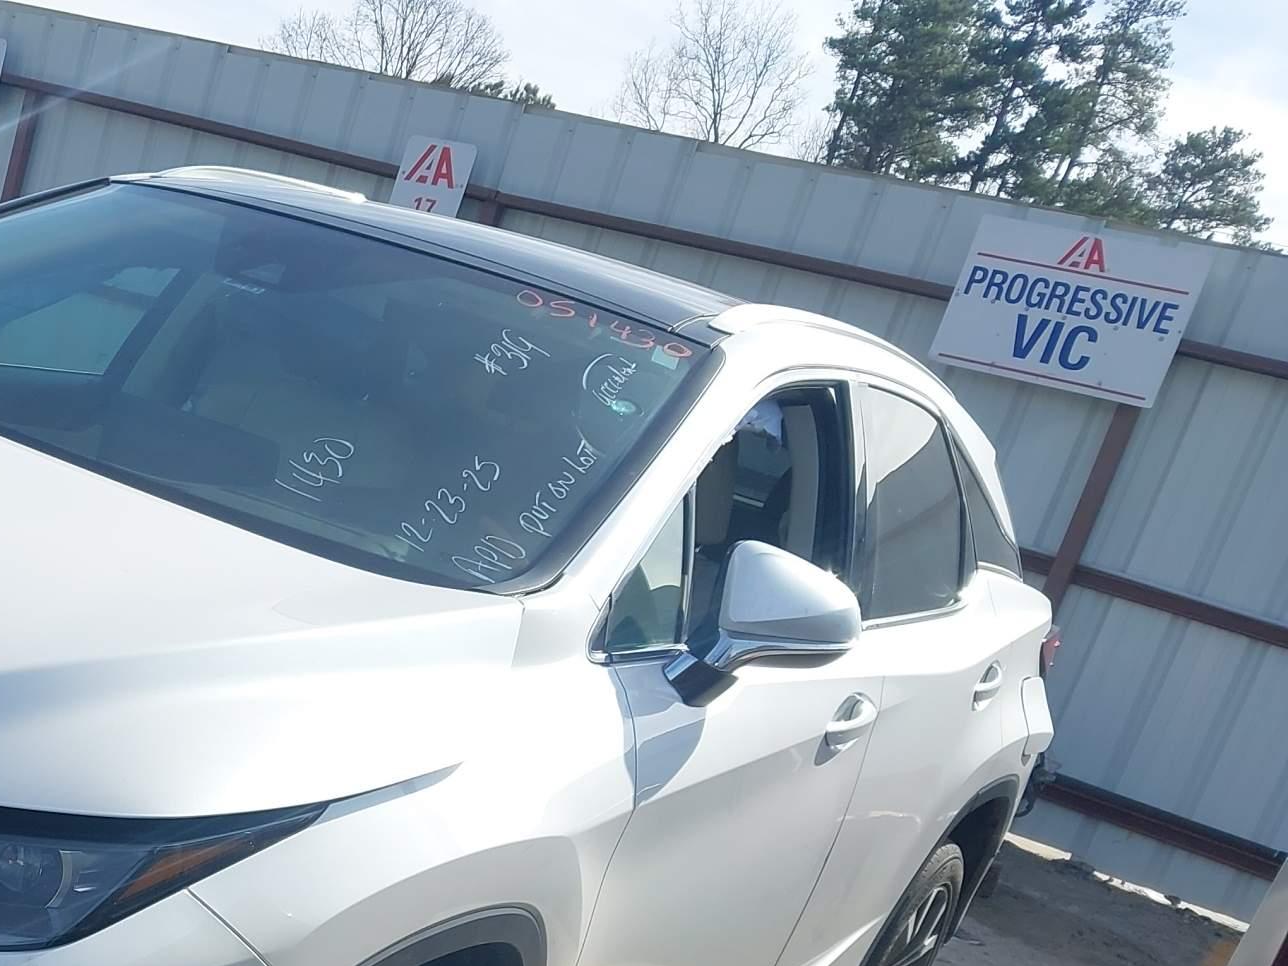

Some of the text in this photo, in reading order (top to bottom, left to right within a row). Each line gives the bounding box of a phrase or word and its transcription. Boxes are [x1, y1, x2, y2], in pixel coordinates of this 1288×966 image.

[414, 197, 437, 213] 17
[964, 265, 1181, 335] PROGRESSIVE
[1012, 313, 1098, 371] VIC
[394, 455, 500, 552] 12-23-25
